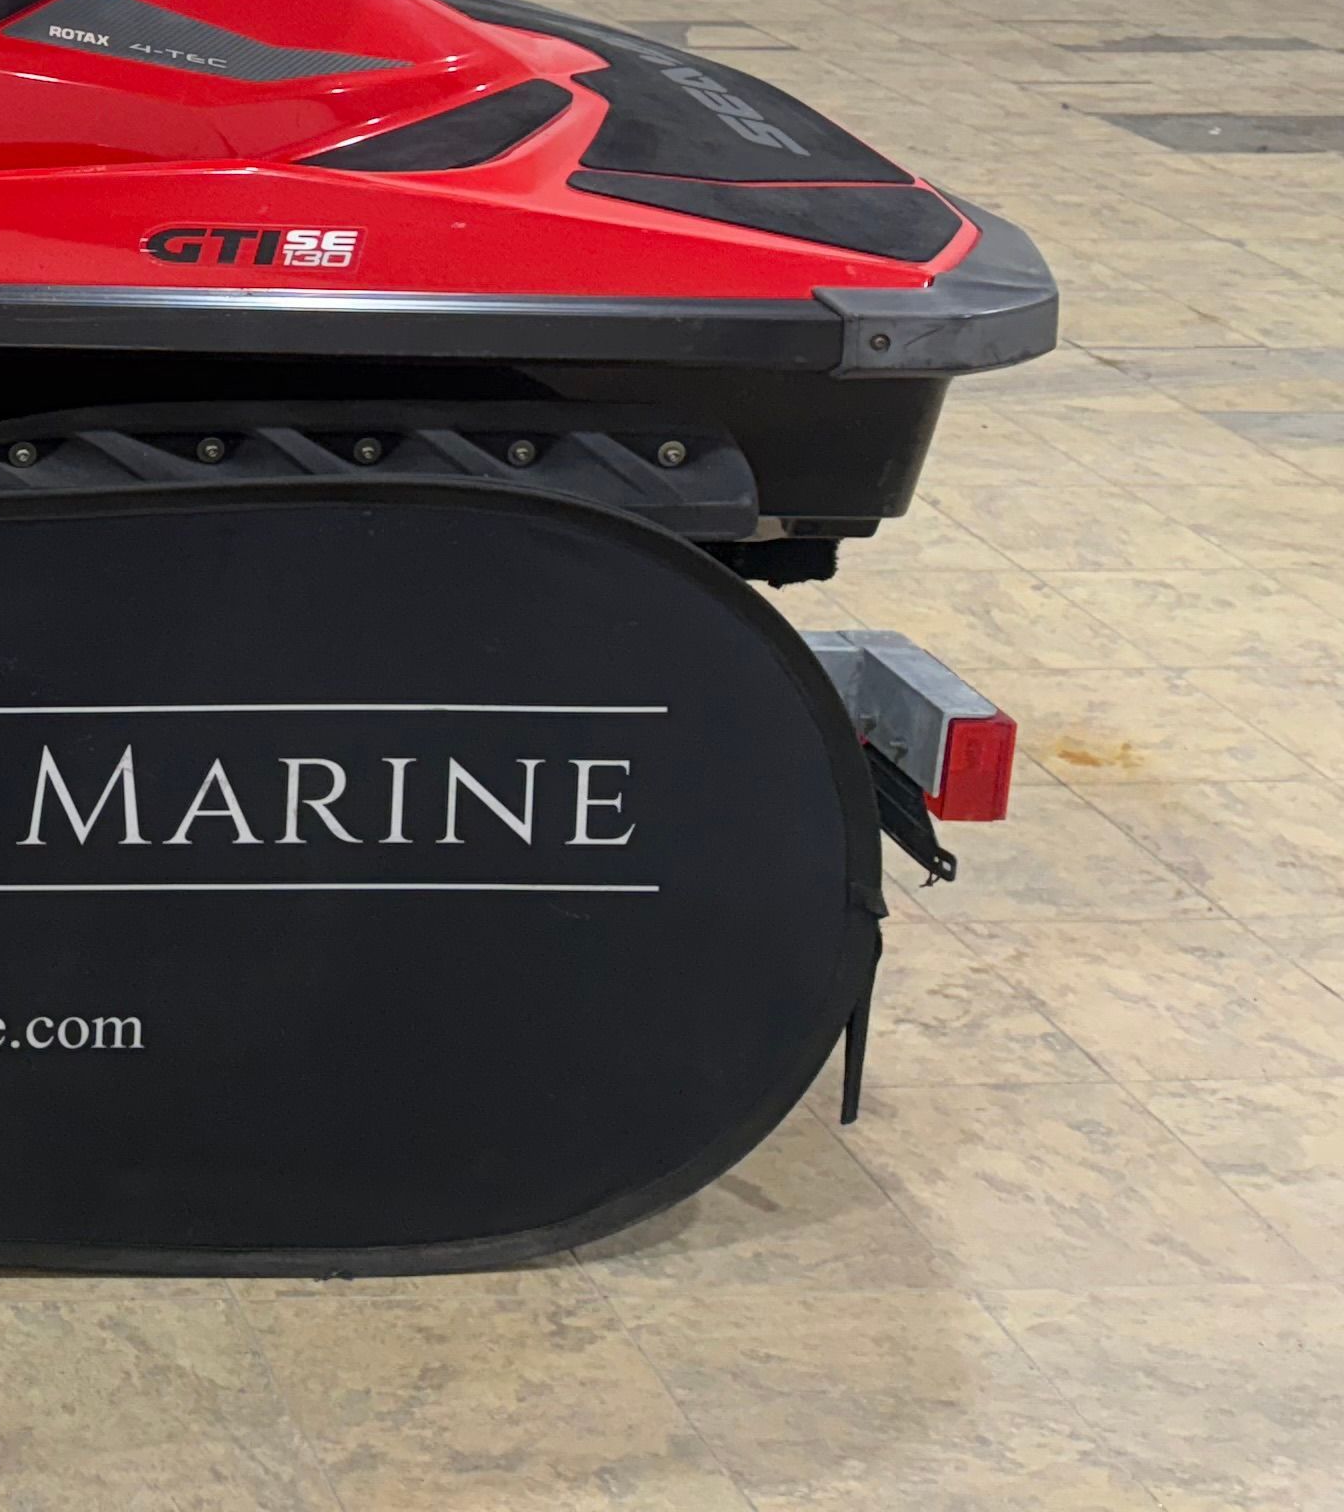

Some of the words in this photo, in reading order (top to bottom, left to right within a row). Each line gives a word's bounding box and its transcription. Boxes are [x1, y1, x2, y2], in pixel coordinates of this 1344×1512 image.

[49, 25, 110, 46] ROTAX
[129, 43, 227, 69] 4-TEC
[145, 228, 281, 265] GTI
[284, 229, 358, 251] SE
[283, 250, 352, 267] 130
[15, 744, 638, 846] MARINE
